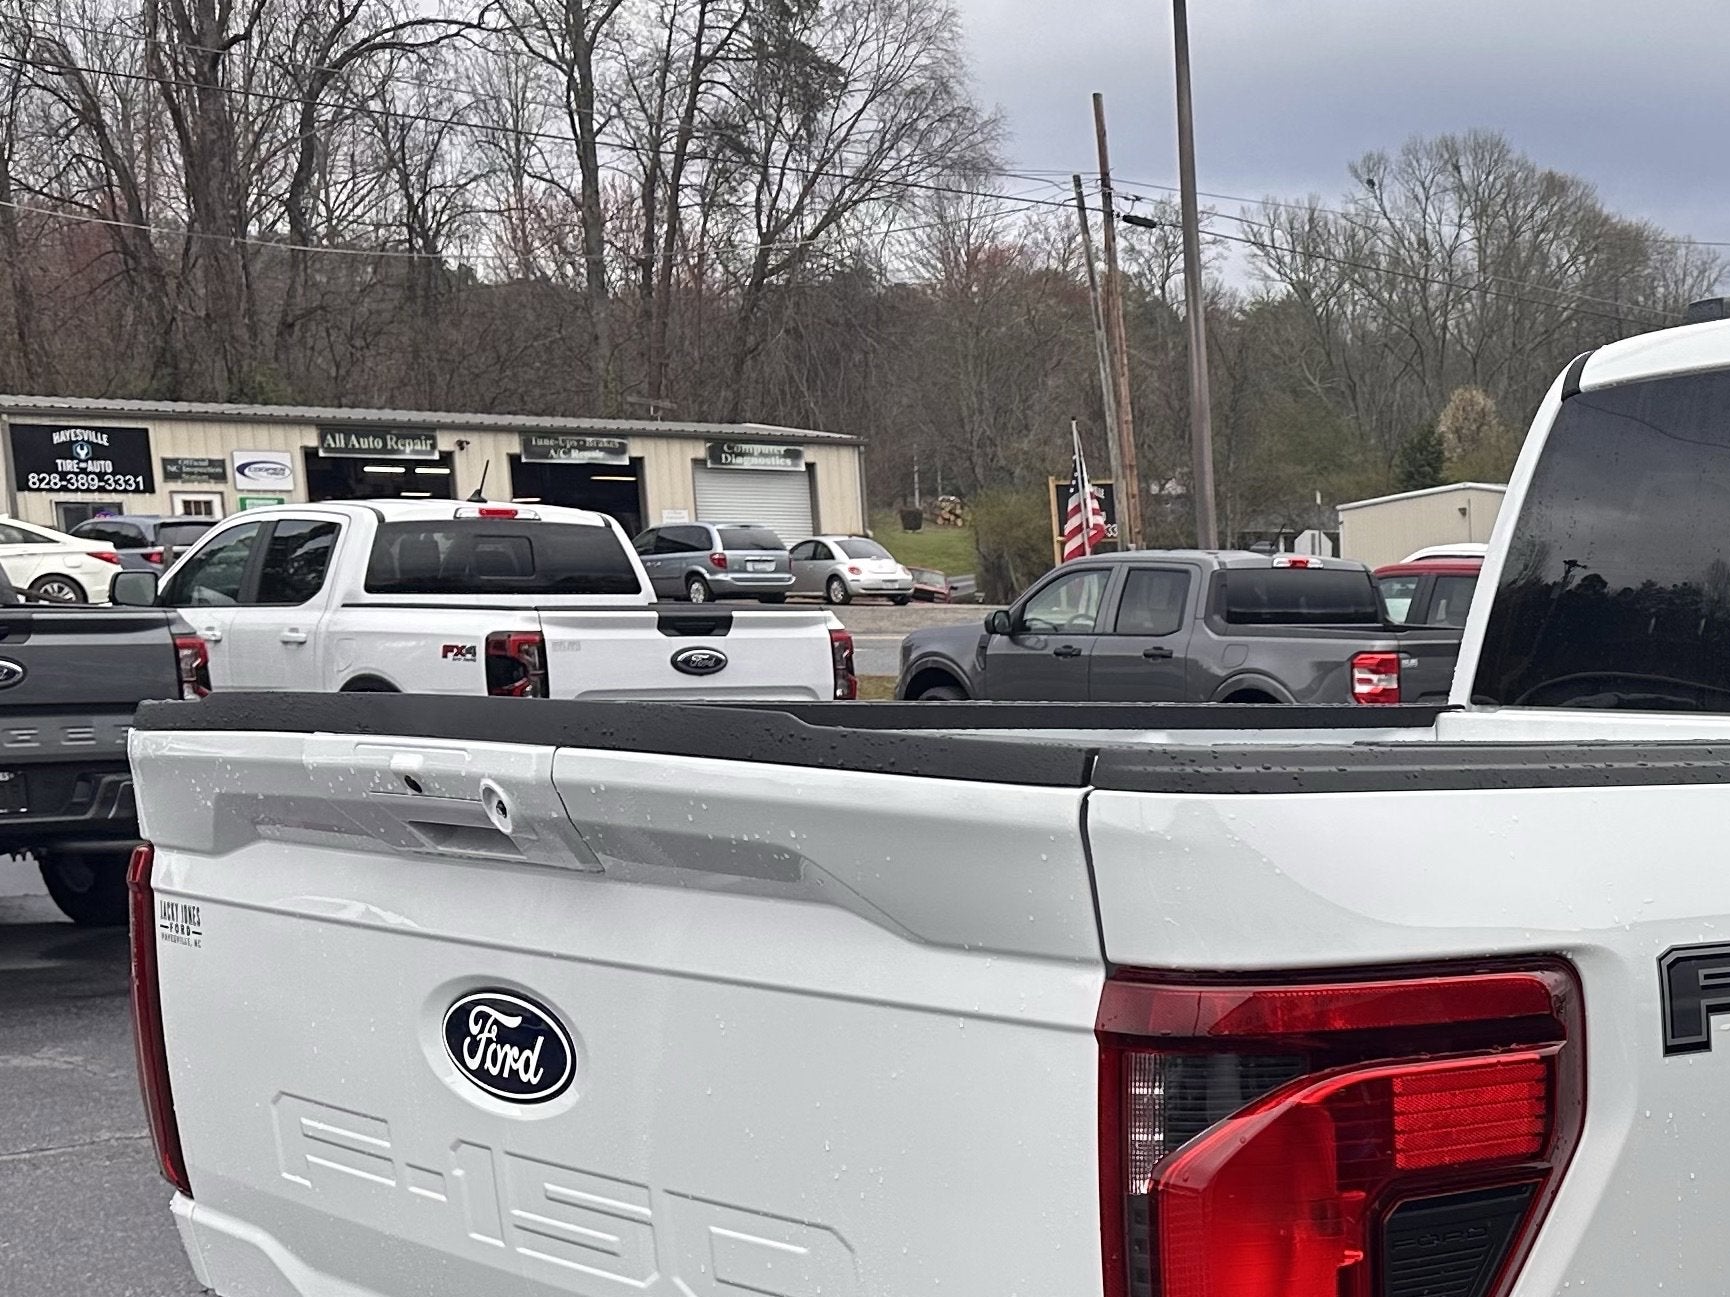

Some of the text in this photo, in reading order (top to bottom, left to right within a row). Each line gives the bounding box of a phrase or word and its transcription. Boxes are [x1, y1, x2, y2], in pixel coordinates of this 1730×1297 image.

[52, 429, 109, 446] HAYESVILLE
[324, 432, 433, 454] All Auto Repair
[723, 443, 785, 455] Computer
[721, 453, 792, 466] Diagnostics
[28, 473, 144, 490] 828-389-3331
[442, 644, 477, 658] FX4
[170, 922, 190, 936] FORD
[463, 1005, 544, 1085] Ford
